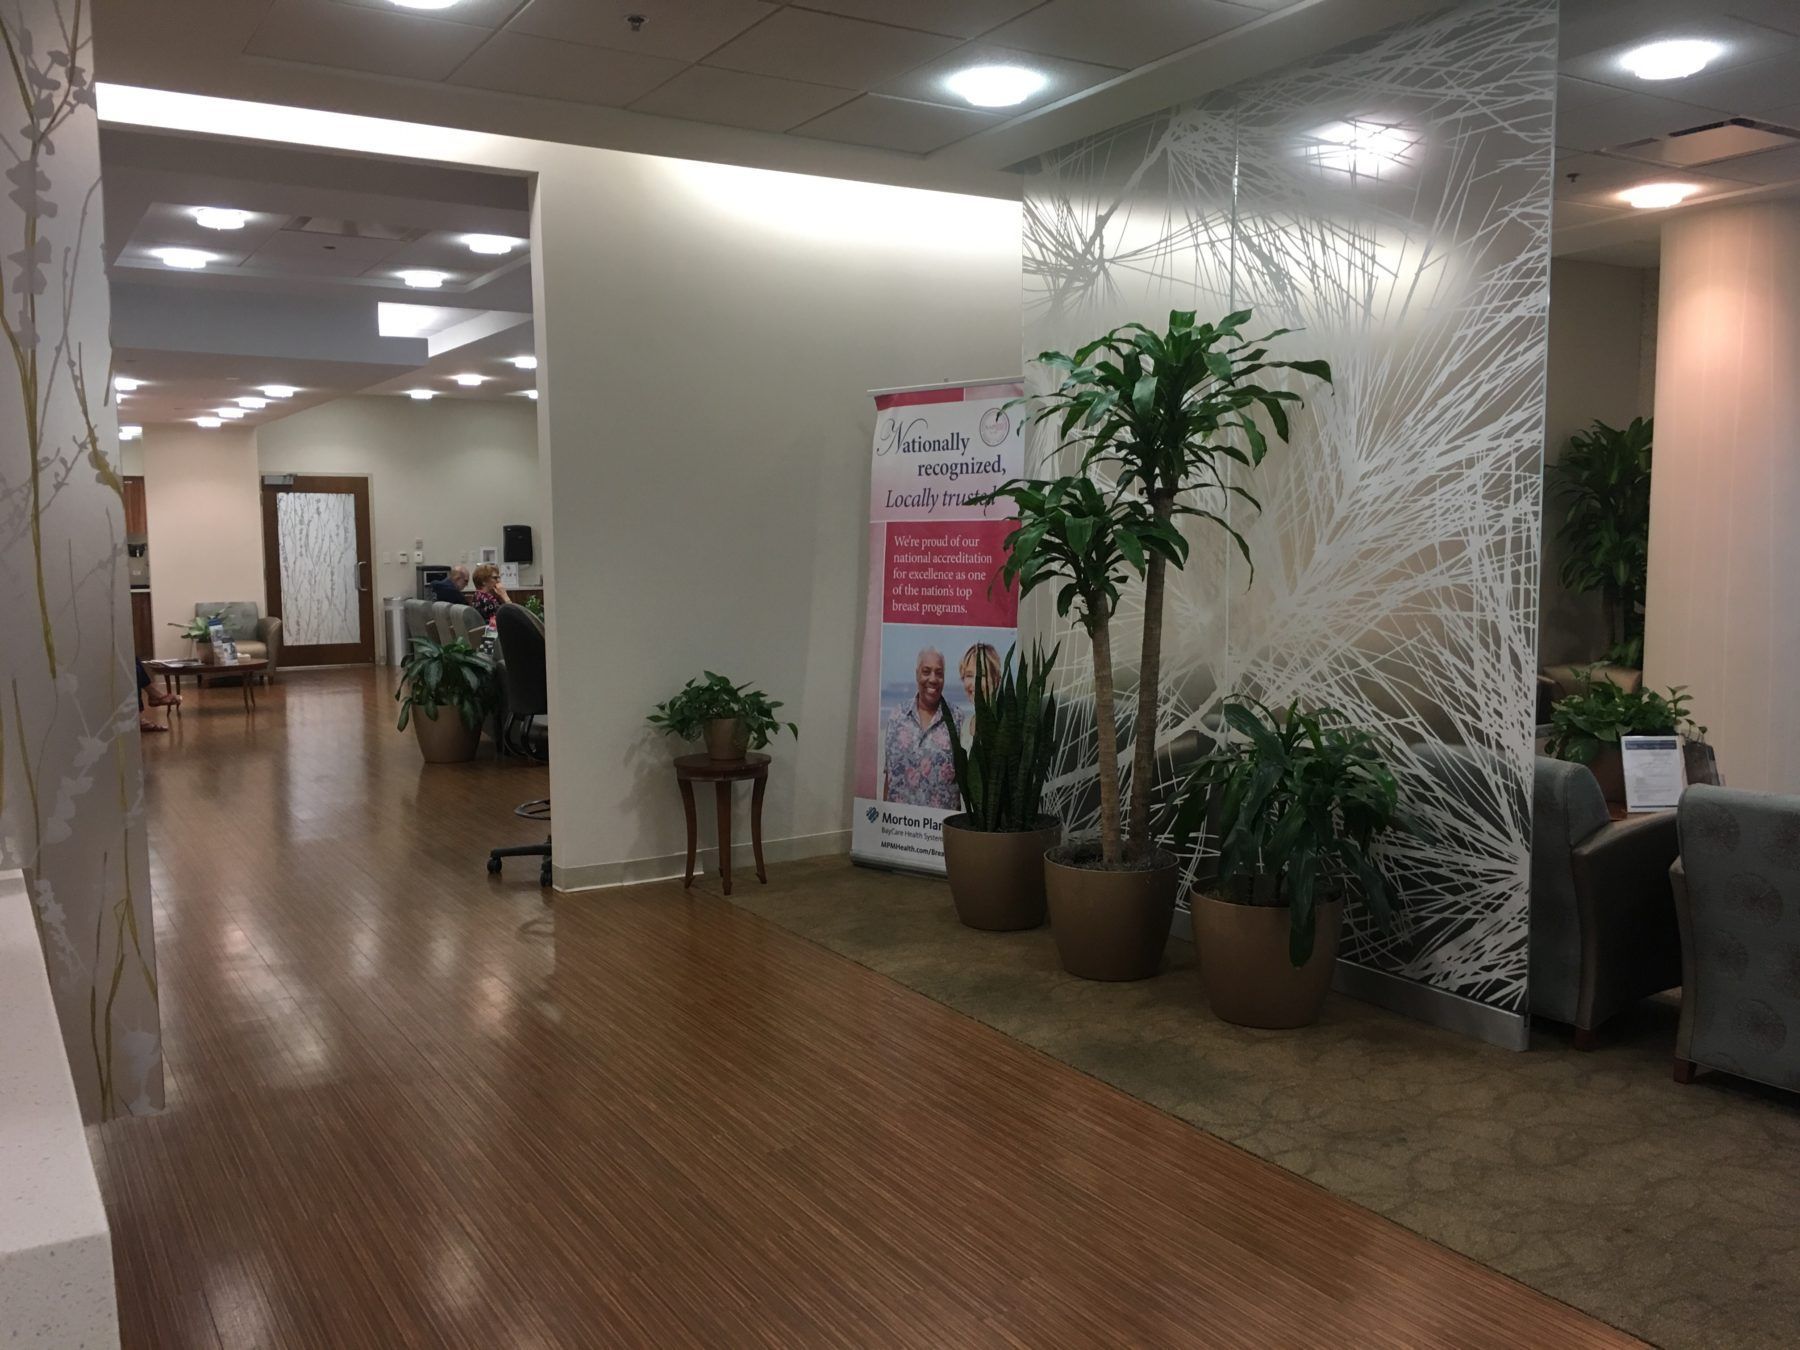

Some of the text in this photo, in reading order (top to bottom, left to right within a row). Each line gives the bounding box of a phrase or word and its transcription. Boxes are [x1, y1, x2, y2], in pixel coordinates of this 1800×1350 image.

[876, 418, 970, 456] Nationally
[917, 455, 1006, 480] recognized,
[885, 488, 939, 513] Locally
[894, 535, 980, 549] We're proud of our
[893, 552, 992, 564] national accreditation
[893, 568, 986, 581] for excellence as one
[892, 584, 973, 600] of the nation's top
[892, 600, 968, 616] breast programs.
[882, 812, 920, 828] Morton
[882, 828, 904, 836] BayCare
[904, 831, 923, 840] Health
